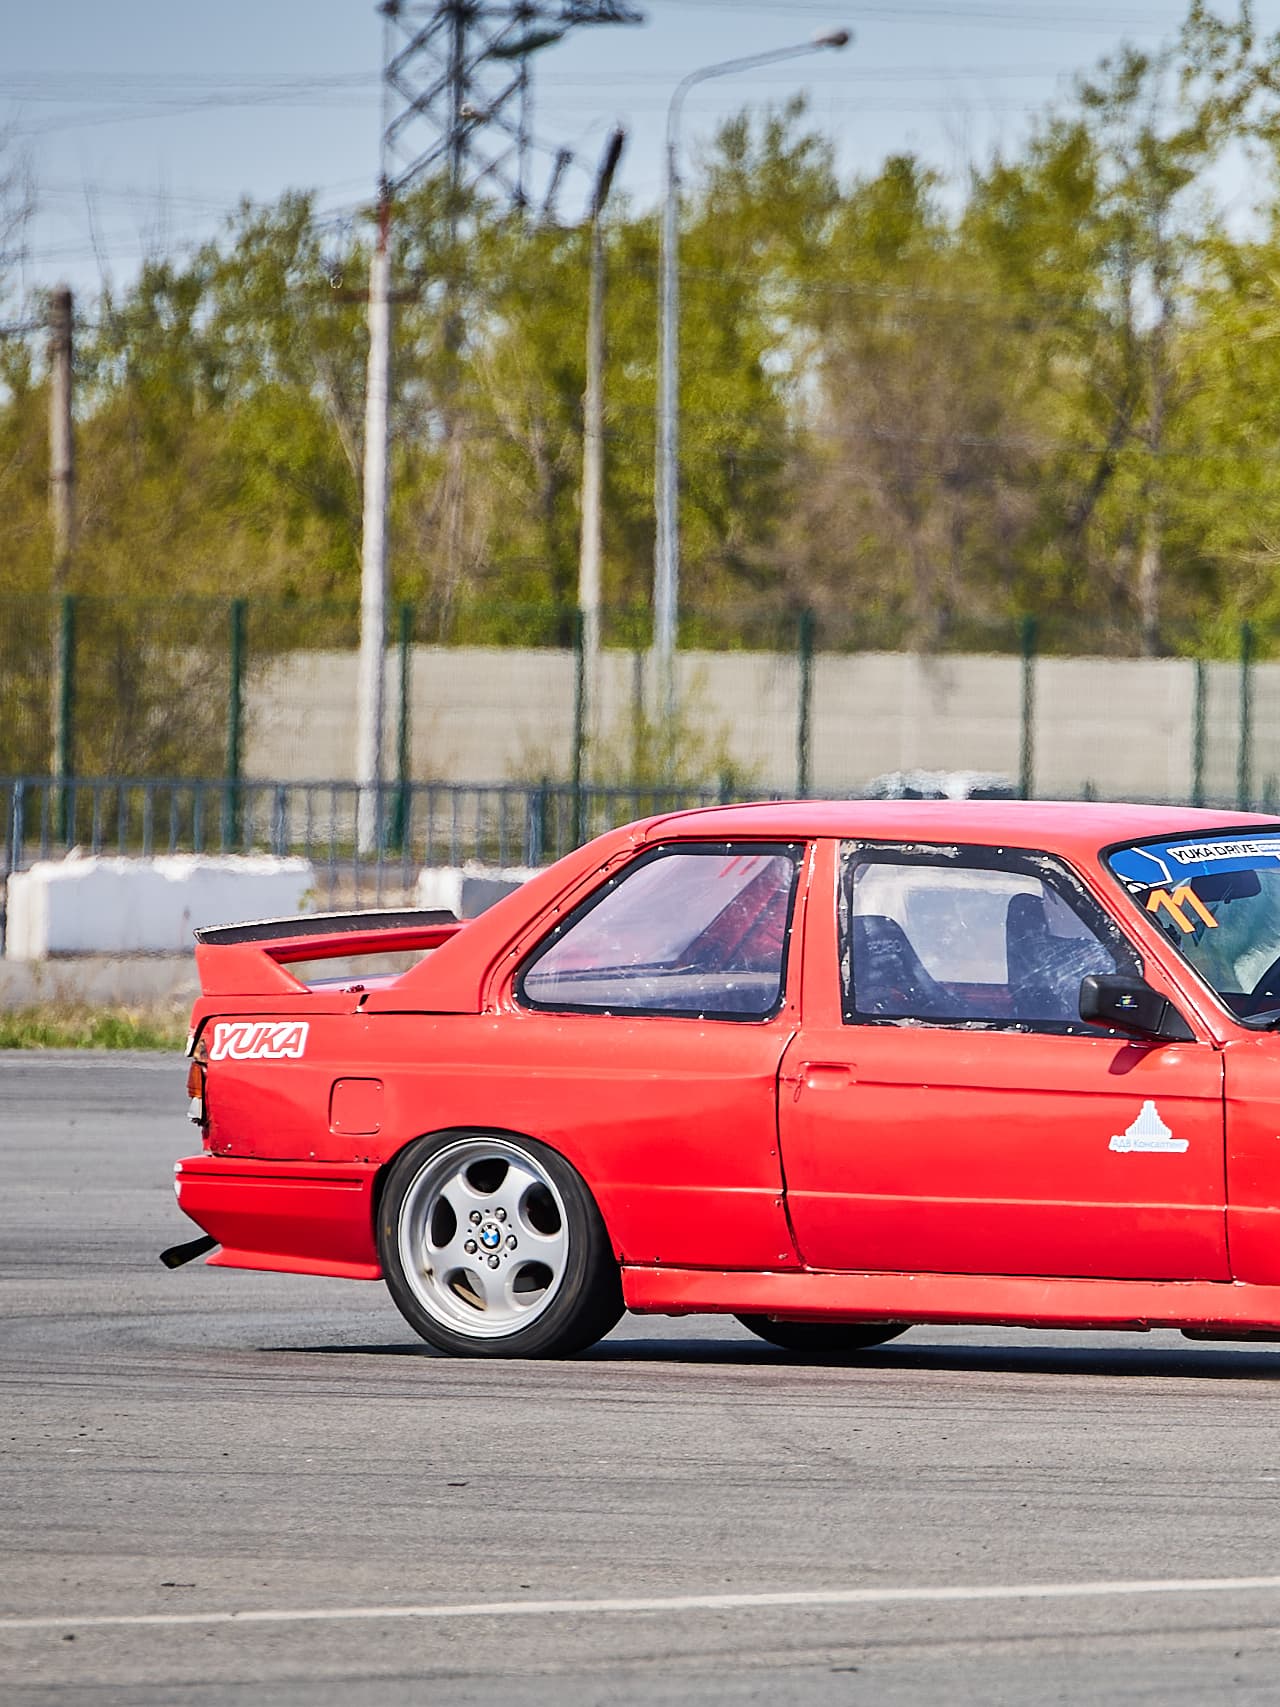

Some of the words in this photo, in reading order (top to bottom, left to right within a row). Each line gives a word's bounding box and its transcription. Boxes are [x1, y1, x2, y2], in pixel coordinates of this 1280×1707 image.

[1172, 847, 1216, 861] YUKA
[1212, 844, 1259, 856] DRIVE
[1146, 885, 1220, 934] 11
[212, 1025, 306, 1058] YUKA
